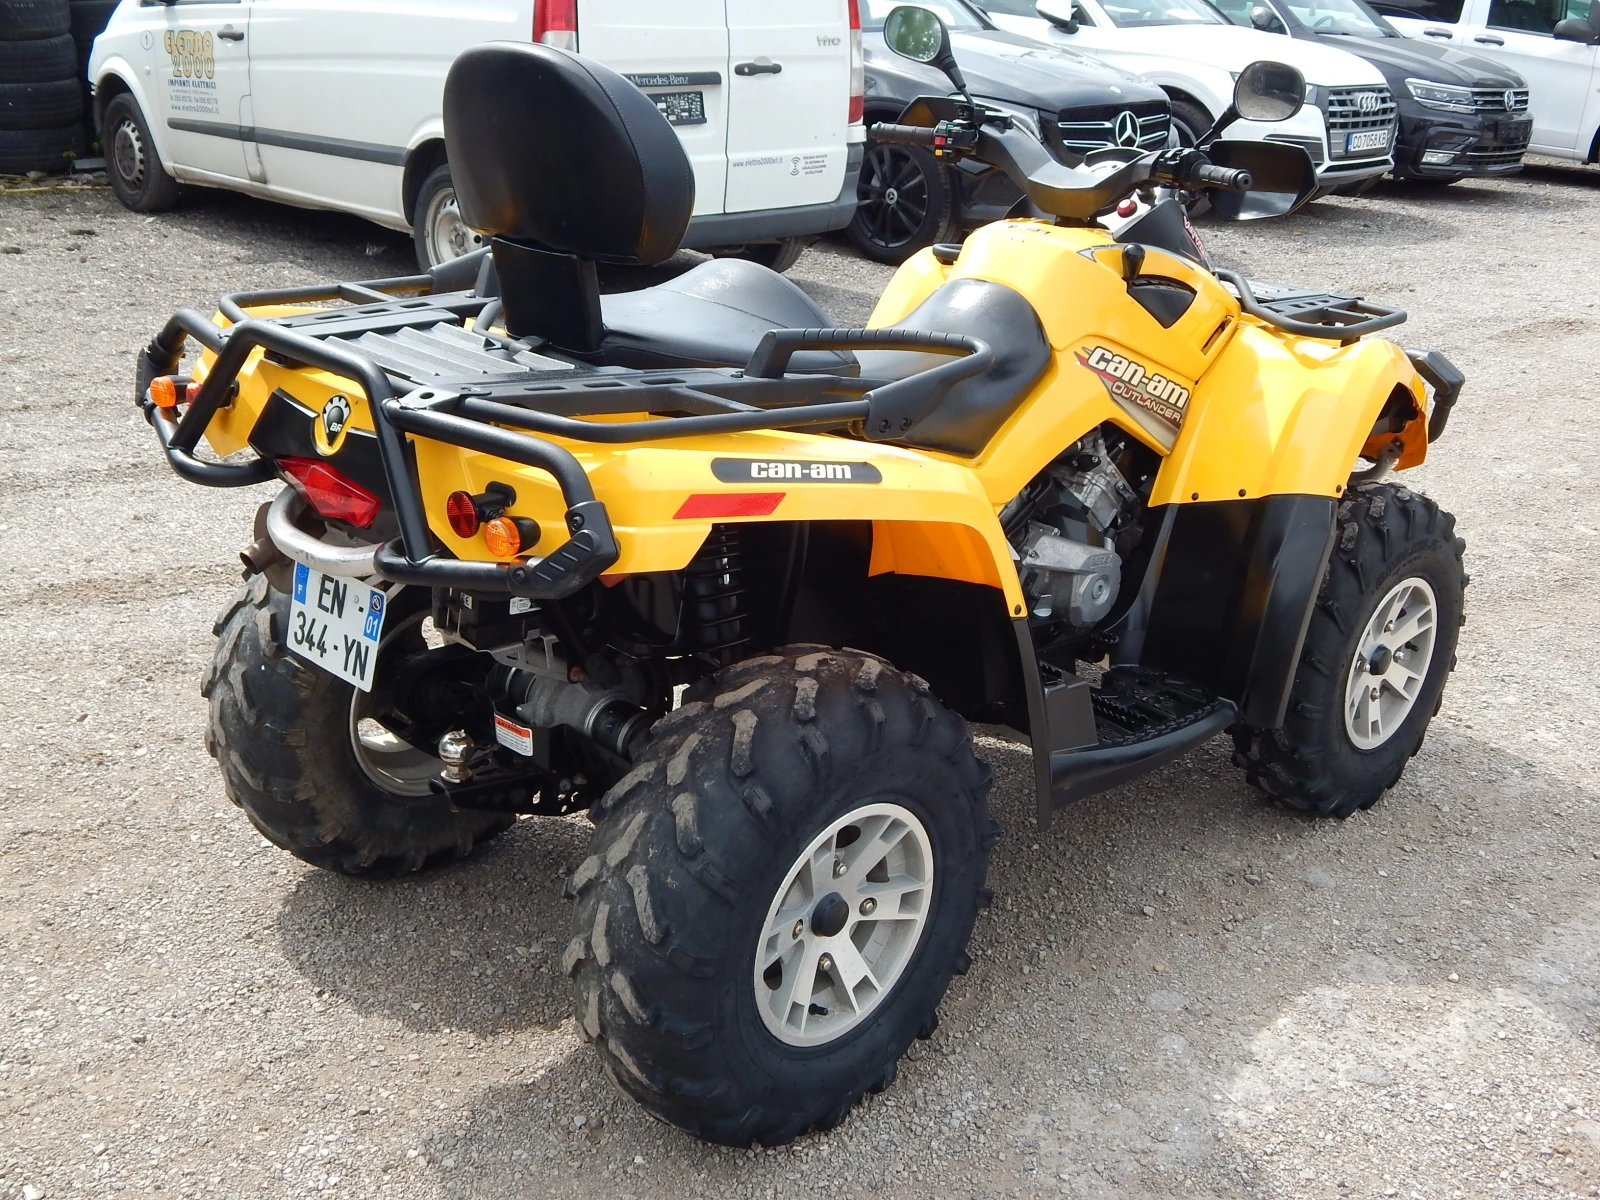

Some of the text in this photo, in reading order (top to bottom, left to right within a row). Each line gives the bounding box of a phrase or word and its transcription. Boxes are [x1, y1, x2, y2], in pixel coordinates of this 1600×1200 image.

[173, 54, 215, 79] 2000
[168, 79, 216, 89] IMPIANTI ELETTRICI
[630, 74, 689, 85] Mercedes-Benz
[733, 156, 783, 167] www.elettro2000srl.it
[1087, 346, 1190, 410] can-am
[1112, 381, 1182, 421] OUTLANDER
[751, 462, 852, 479] can-am
[298, 584, 303, 594] F
[317, 573, 347, 619] EN
[366, 615, 378, 637] 01
